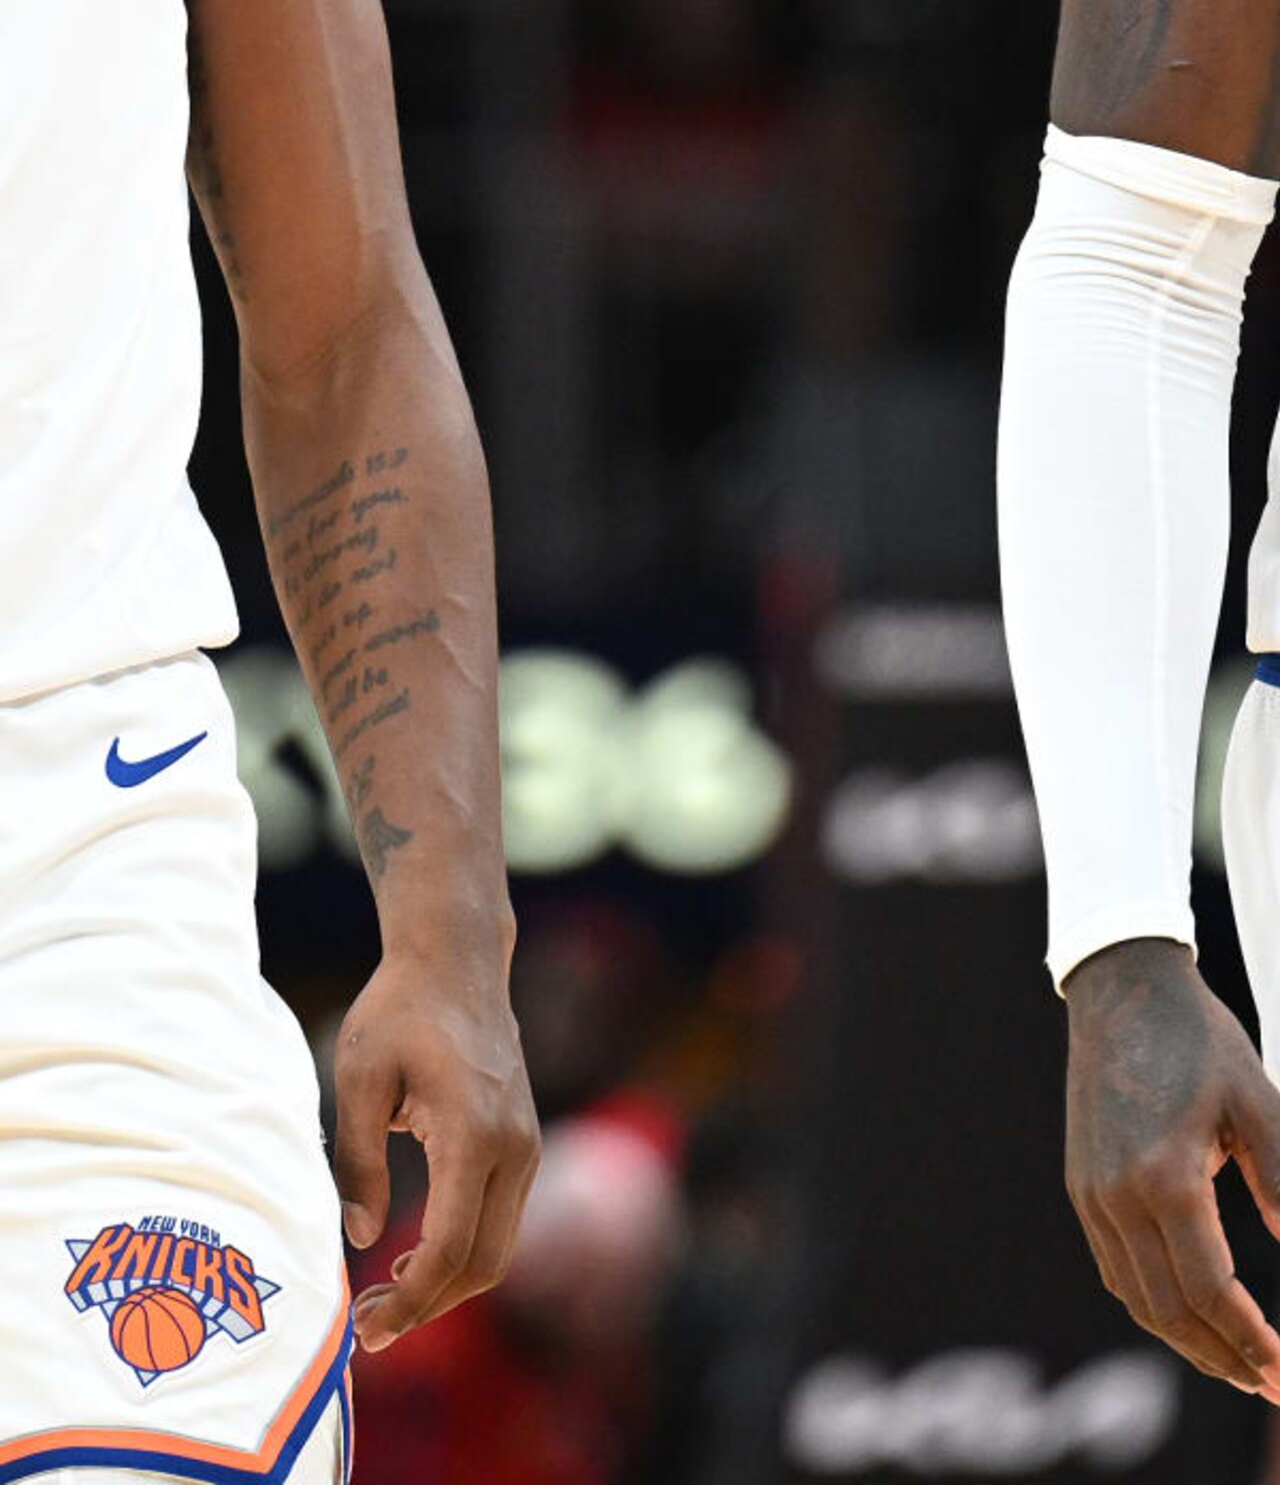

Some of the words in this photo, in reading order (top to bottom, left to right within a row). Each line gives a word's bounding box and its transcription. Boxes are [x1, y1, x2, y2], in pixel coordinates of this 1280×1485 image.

[137, 1215, 177, 1233] NEW
[180, 1218, 222, 1247] YORK
[64, 1223, 266, 1333] KNICKS
